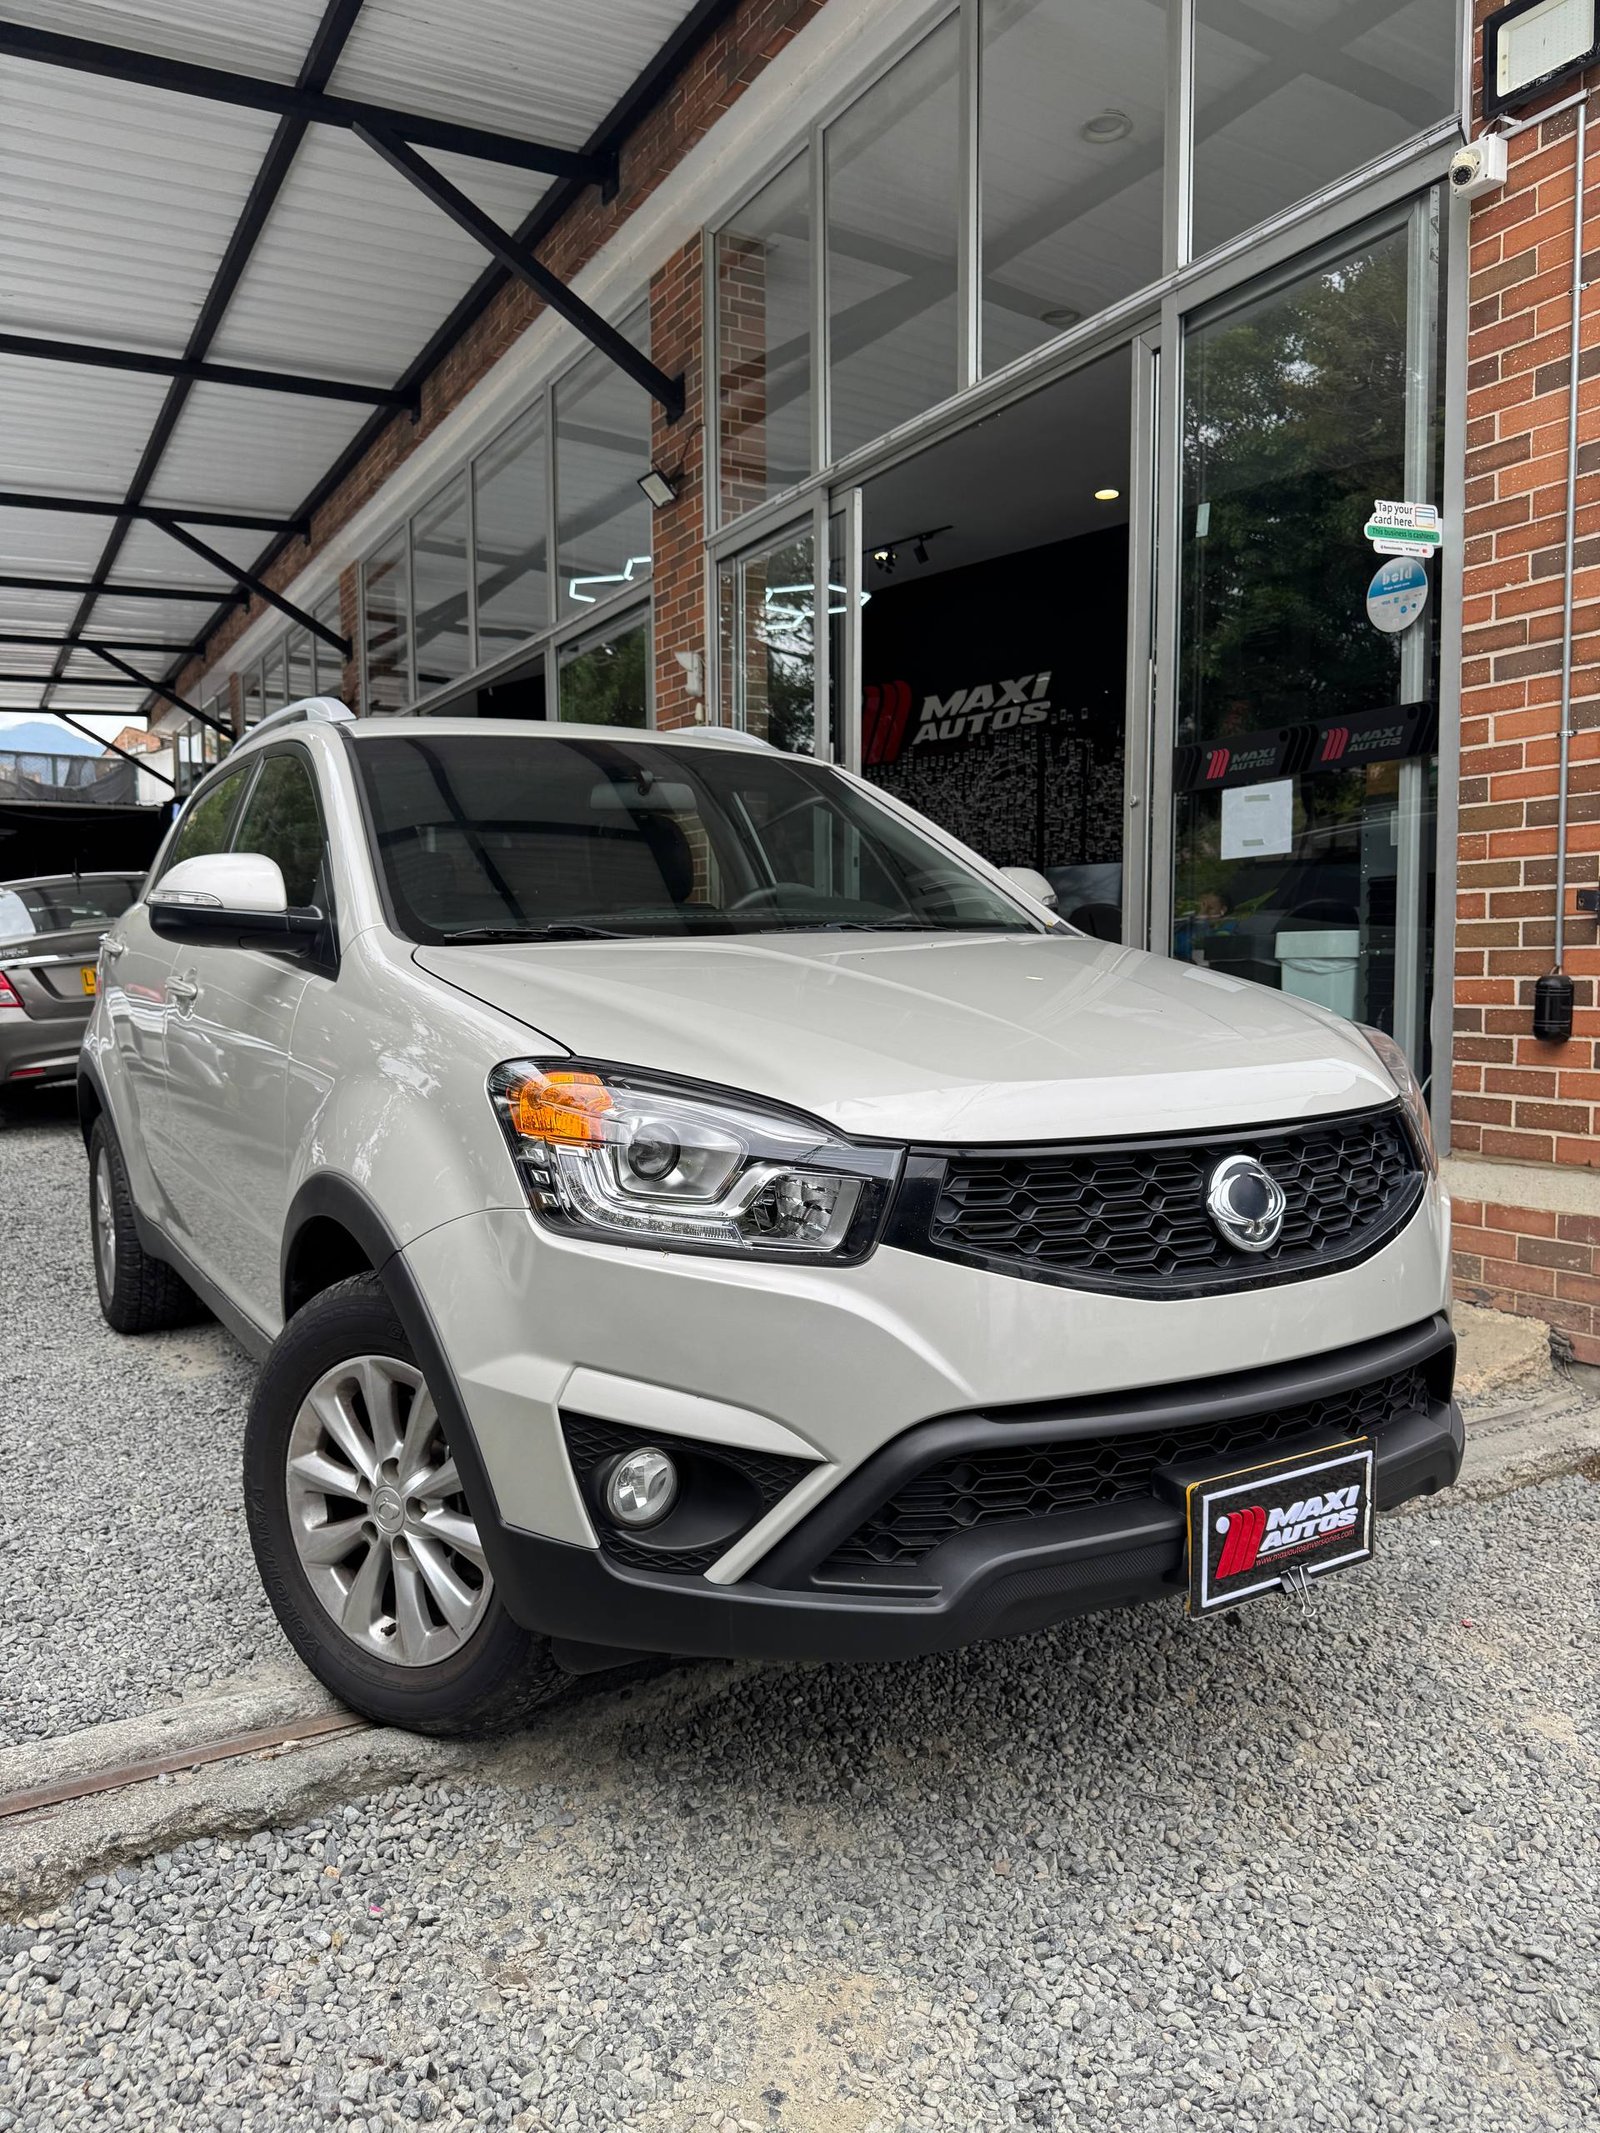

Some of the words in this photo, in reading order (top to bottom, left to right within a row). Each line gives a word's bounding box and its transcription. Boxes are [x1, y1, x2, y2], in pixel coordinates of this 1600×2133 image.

[1378, 502, 1393, 514] Tap
[1394, 505, 1413, 515] your
[1374, 515, 1392, 525] card
[1394, 516, 1415, 527] here.
[1372, 527, 1383, 535] This
[1384, 529, 1407, 537] business
[1382, 566, 1413, 586] bold
[920, 671, 1052, 722] MAXI
[912, 700, 1051, 746] AUTOS
[1351, 725, 1404, 743] MAXI
[1348, 736, 1403, 753] AUTOS
[1231, 747, 1277, 763] MAXI
[1228, 757, 1275, 772] AUTOS
[1265, 1485, 1361, 1531] MAXI
[1259, 1507, 1359, 1552] AUTOS
